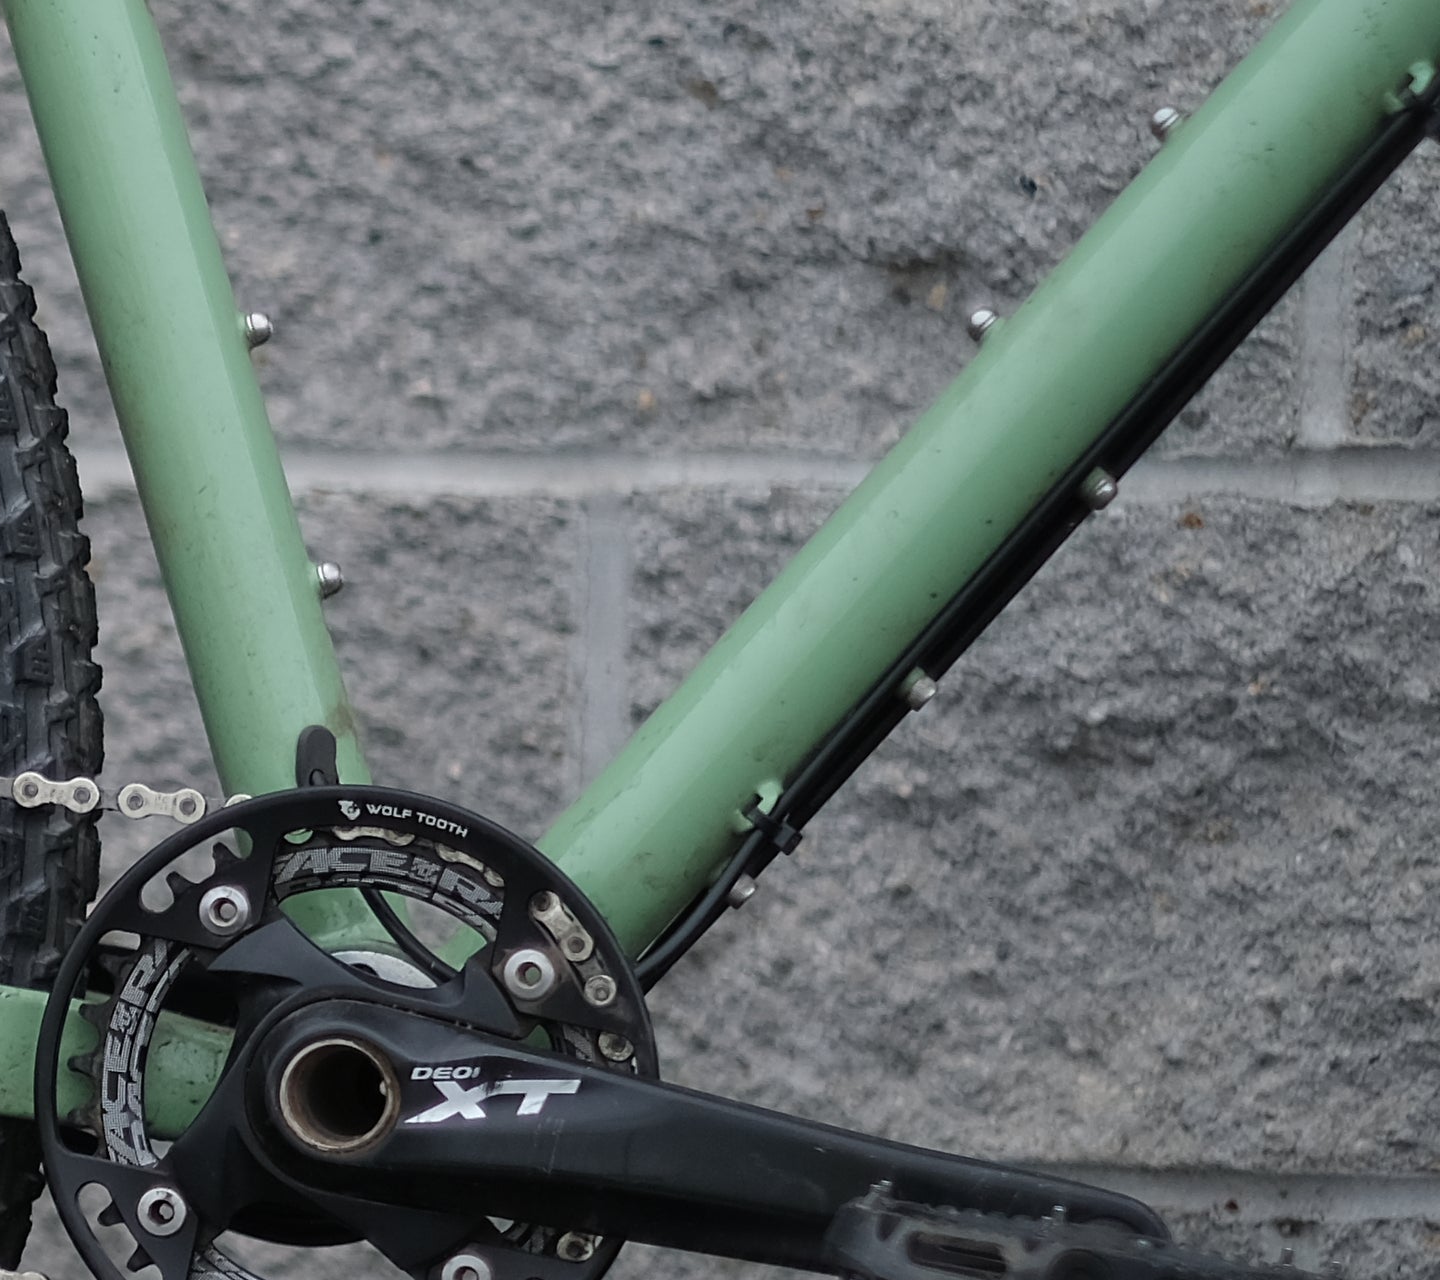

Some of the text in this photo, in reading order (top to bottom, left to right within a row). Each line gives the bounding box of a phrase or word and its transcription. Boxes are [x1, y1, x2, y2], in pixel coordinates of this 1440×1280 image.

[366, 803, 468, 838] WOLF TOOTH
[274, 846, 409, 885] ACE
[411, 1066, 481, 1080] DEO
[404, 1079, 582, 1123] XT
